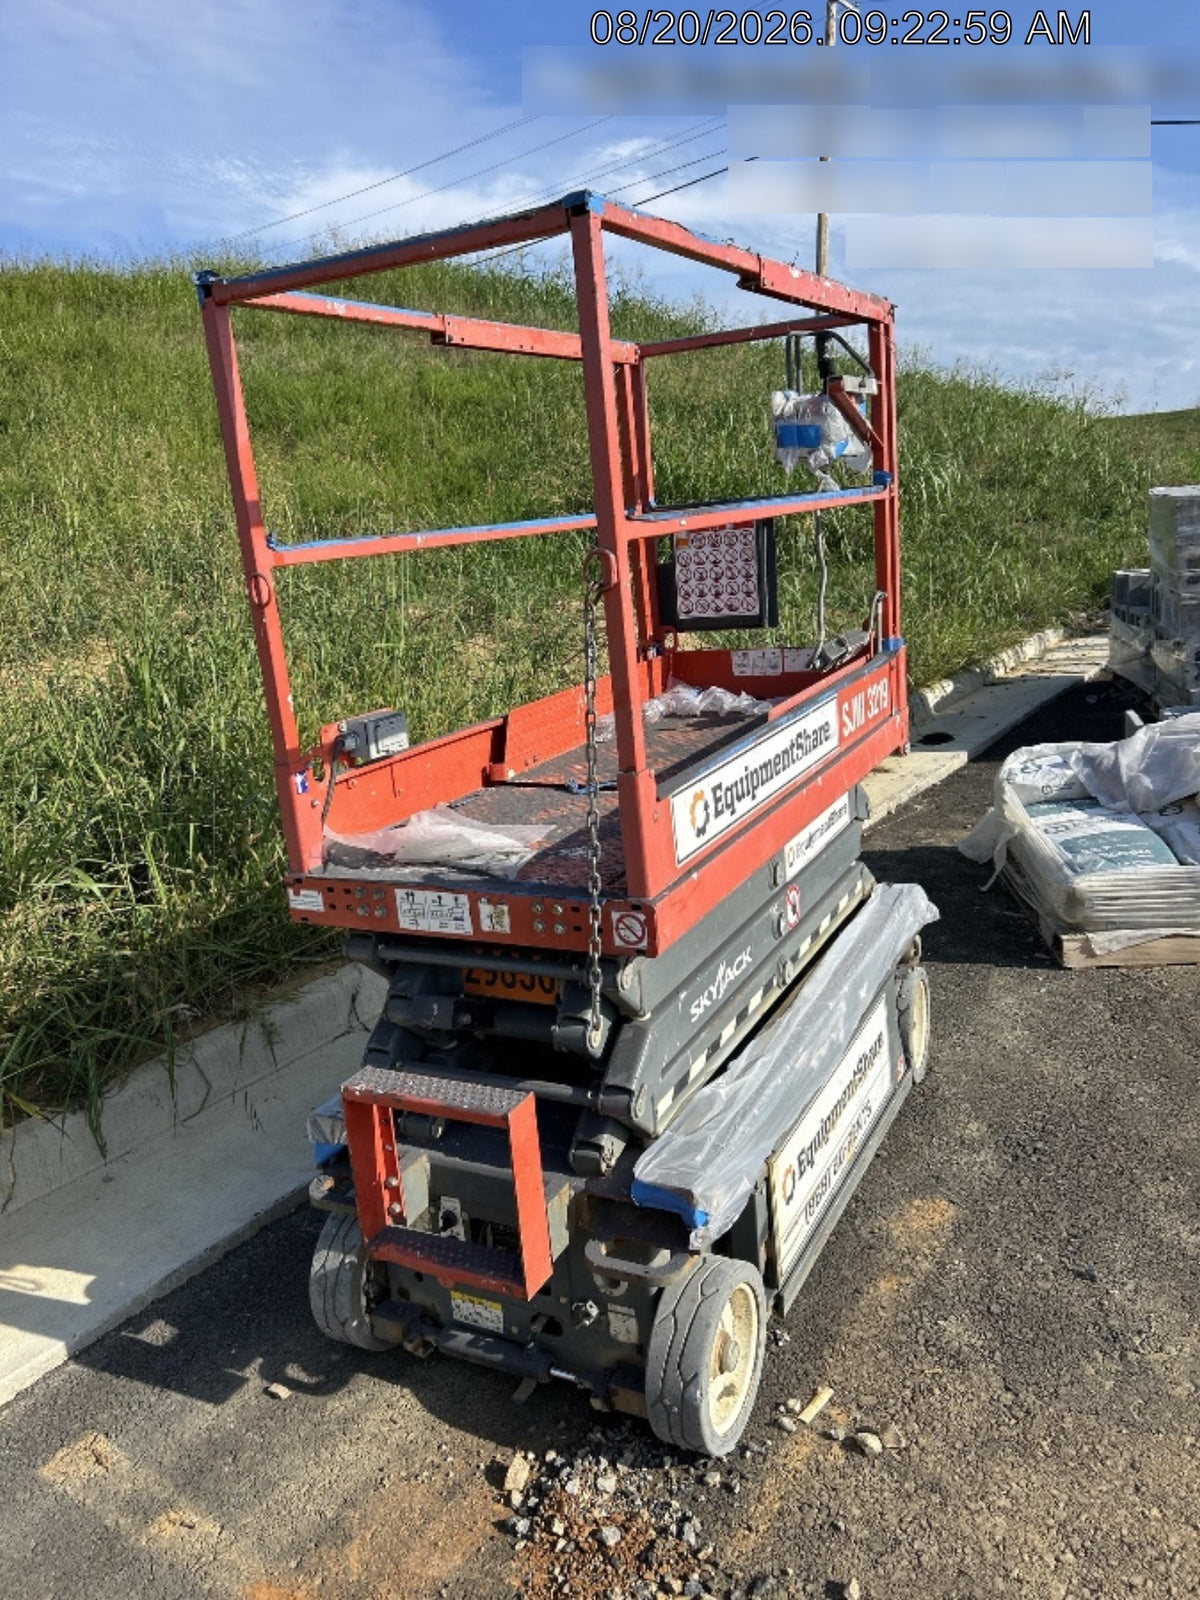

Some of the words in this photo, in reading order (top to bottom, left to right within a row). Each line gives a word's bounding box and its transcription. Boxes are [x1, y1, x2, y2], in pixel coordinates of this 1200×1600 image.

[867, 677, 889, 719] 3219
[711, 722, 831, 819] EquipmentShare
[690, 945, 753, 1023] SKYJACK
